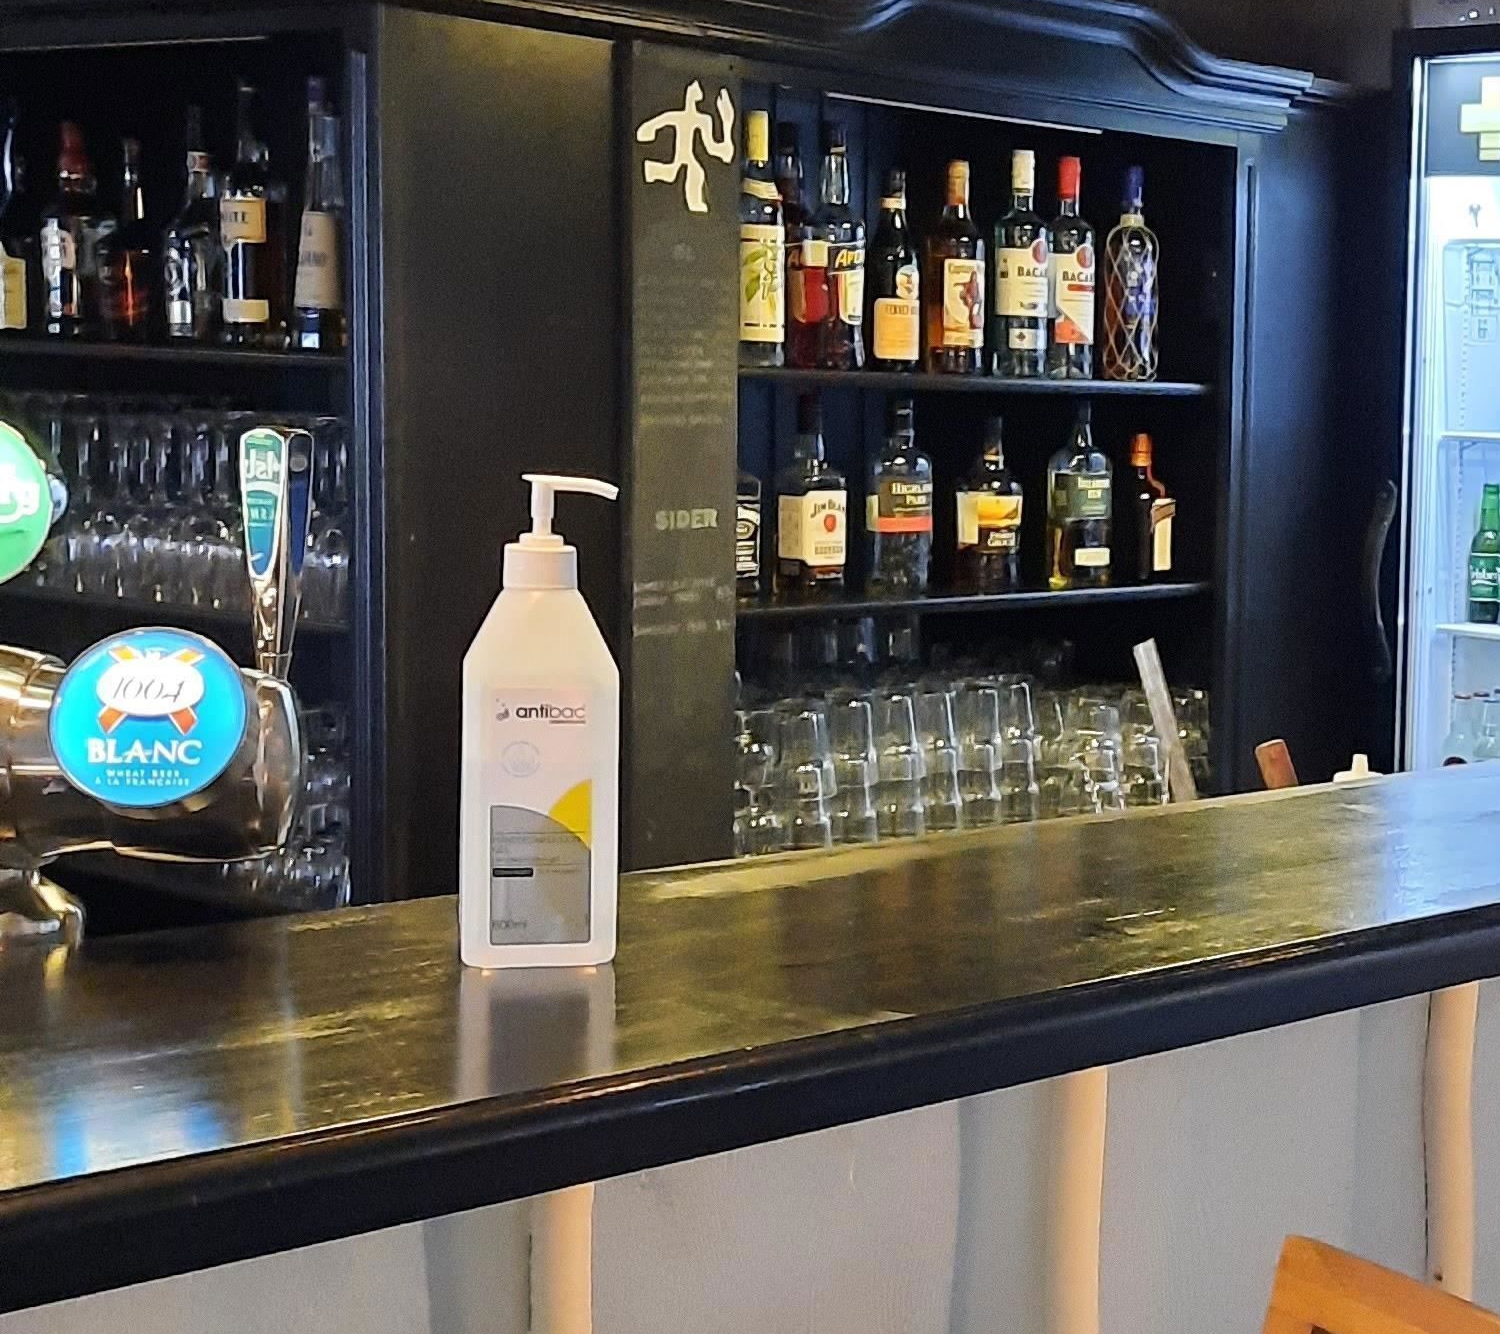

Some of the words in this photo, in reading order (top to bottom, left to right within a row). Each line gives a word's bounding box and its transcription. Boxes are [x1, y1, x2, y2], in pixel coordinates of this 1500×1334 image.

[655, 508, 718, 530] SIDER
[515, 703, 586, 719] antibac
[87, 737, 203, 766] BLANC
